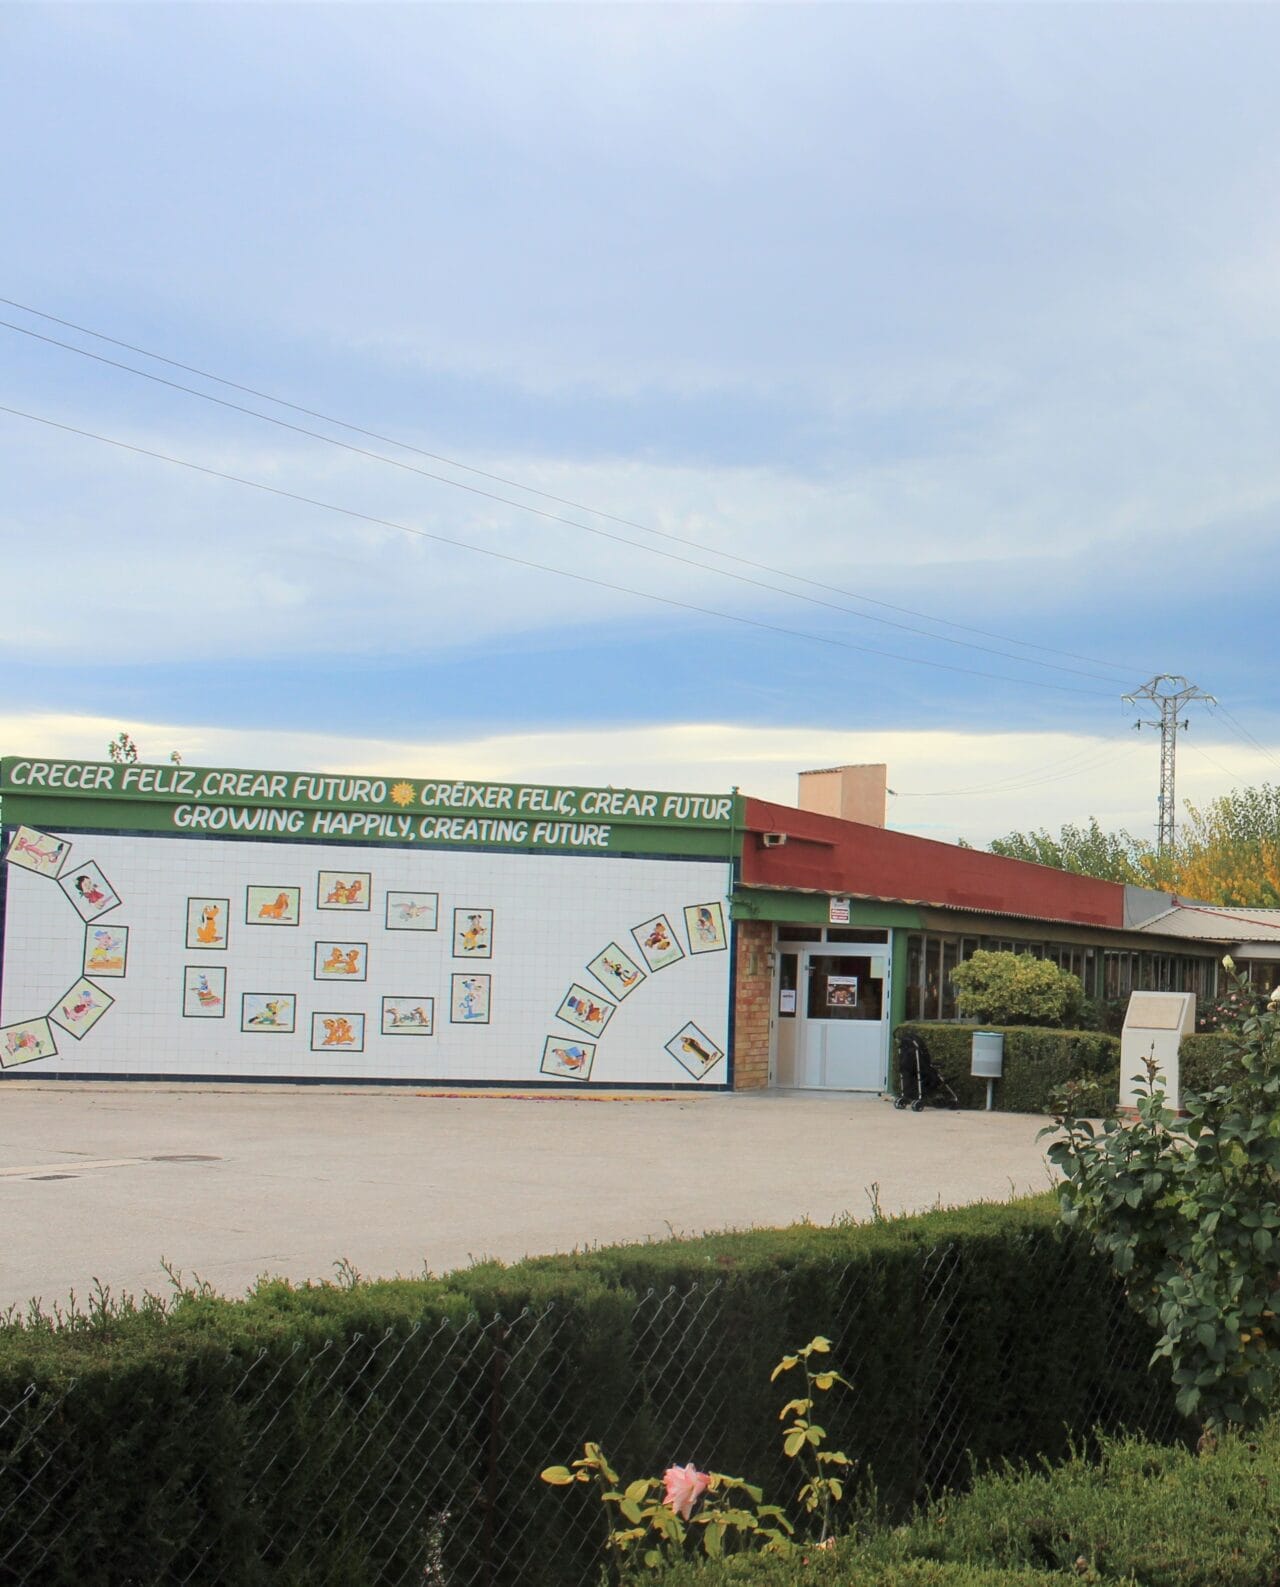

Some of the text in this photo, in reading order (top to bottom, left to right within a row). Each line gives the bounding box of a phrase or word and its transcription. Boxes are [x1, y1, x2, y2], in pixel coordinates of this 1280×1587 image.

[10, 761, 115, 790] CRECER
[292, 776, 387, 803] FUTURO
[173, 804, 611, 847] GROWING HAPPILY, CREATING FUTURE
[580, 791, 655, 817] CREAR
[662, 796, 732, 820] FUTUR
